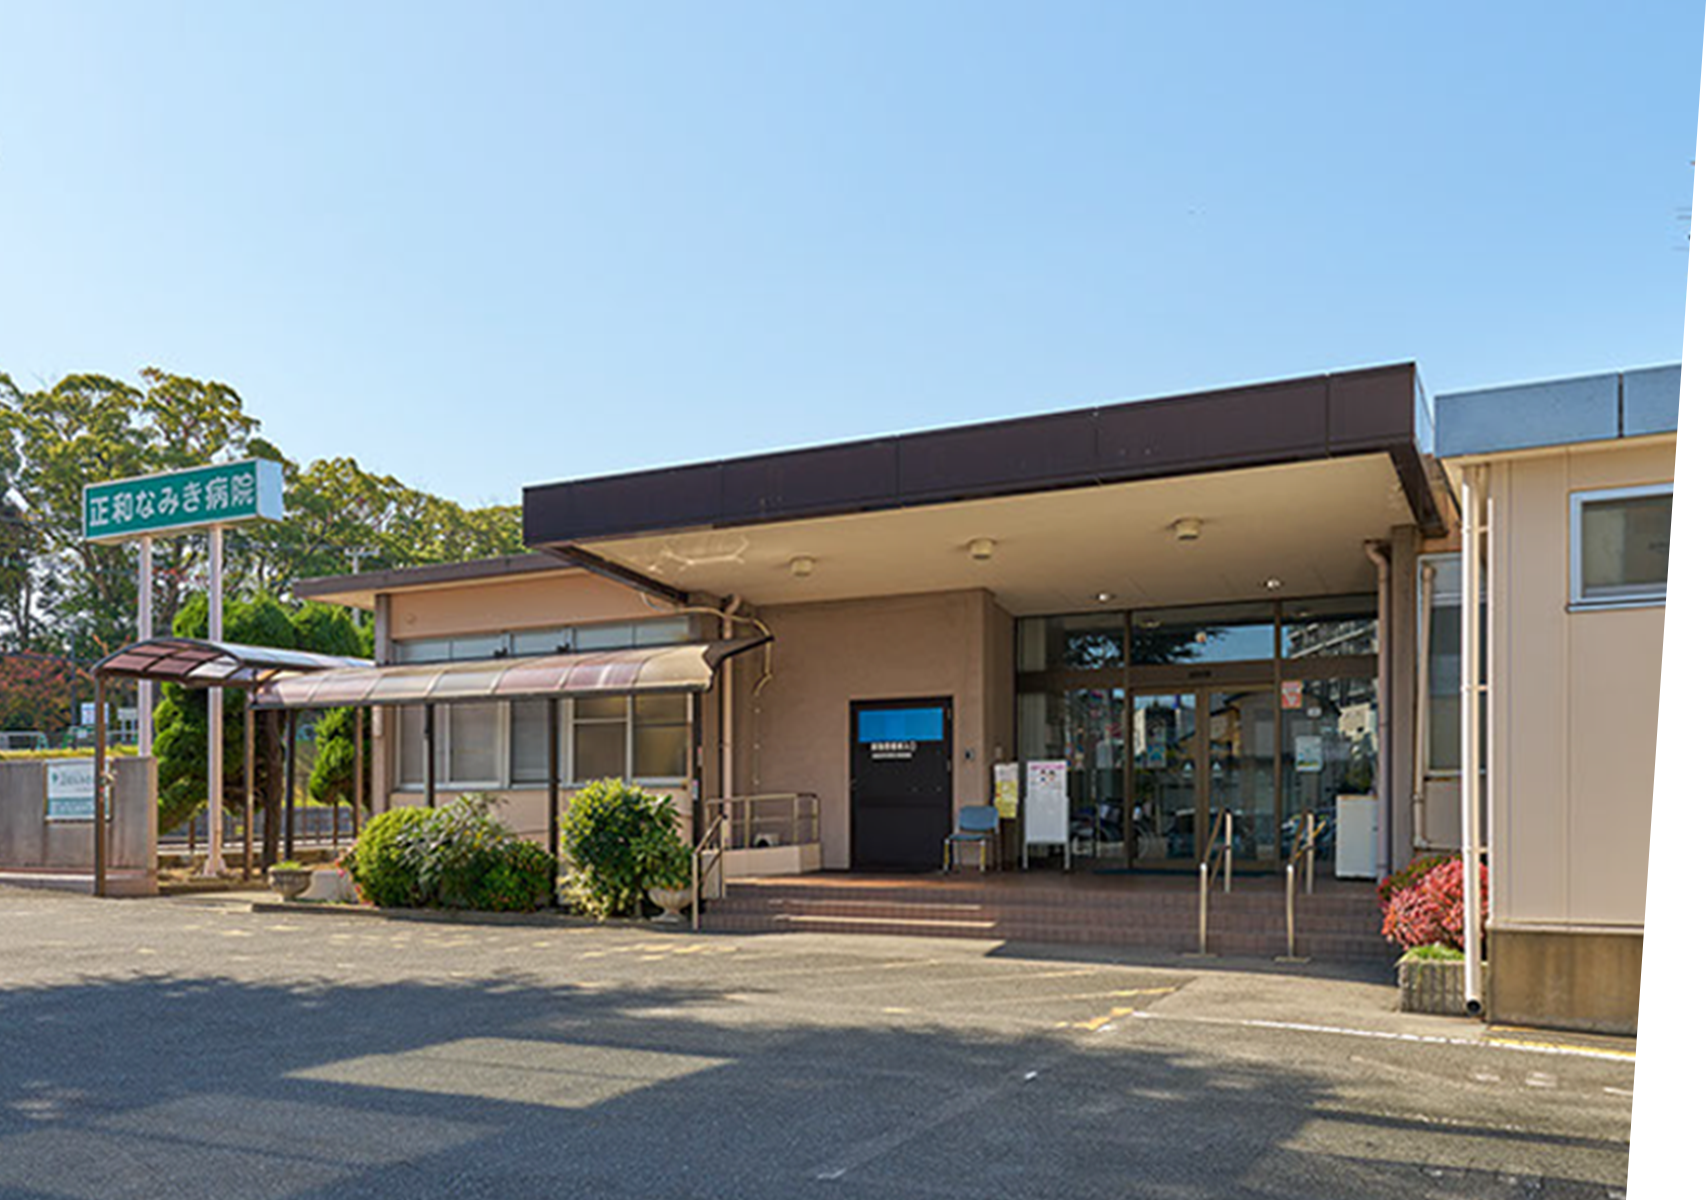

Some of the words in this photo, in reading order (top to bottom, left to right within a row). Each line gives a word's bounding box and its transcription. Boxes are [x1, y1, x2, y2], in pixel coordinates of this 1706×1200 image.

[89, 472, 255, 527] 正和なみき病院
